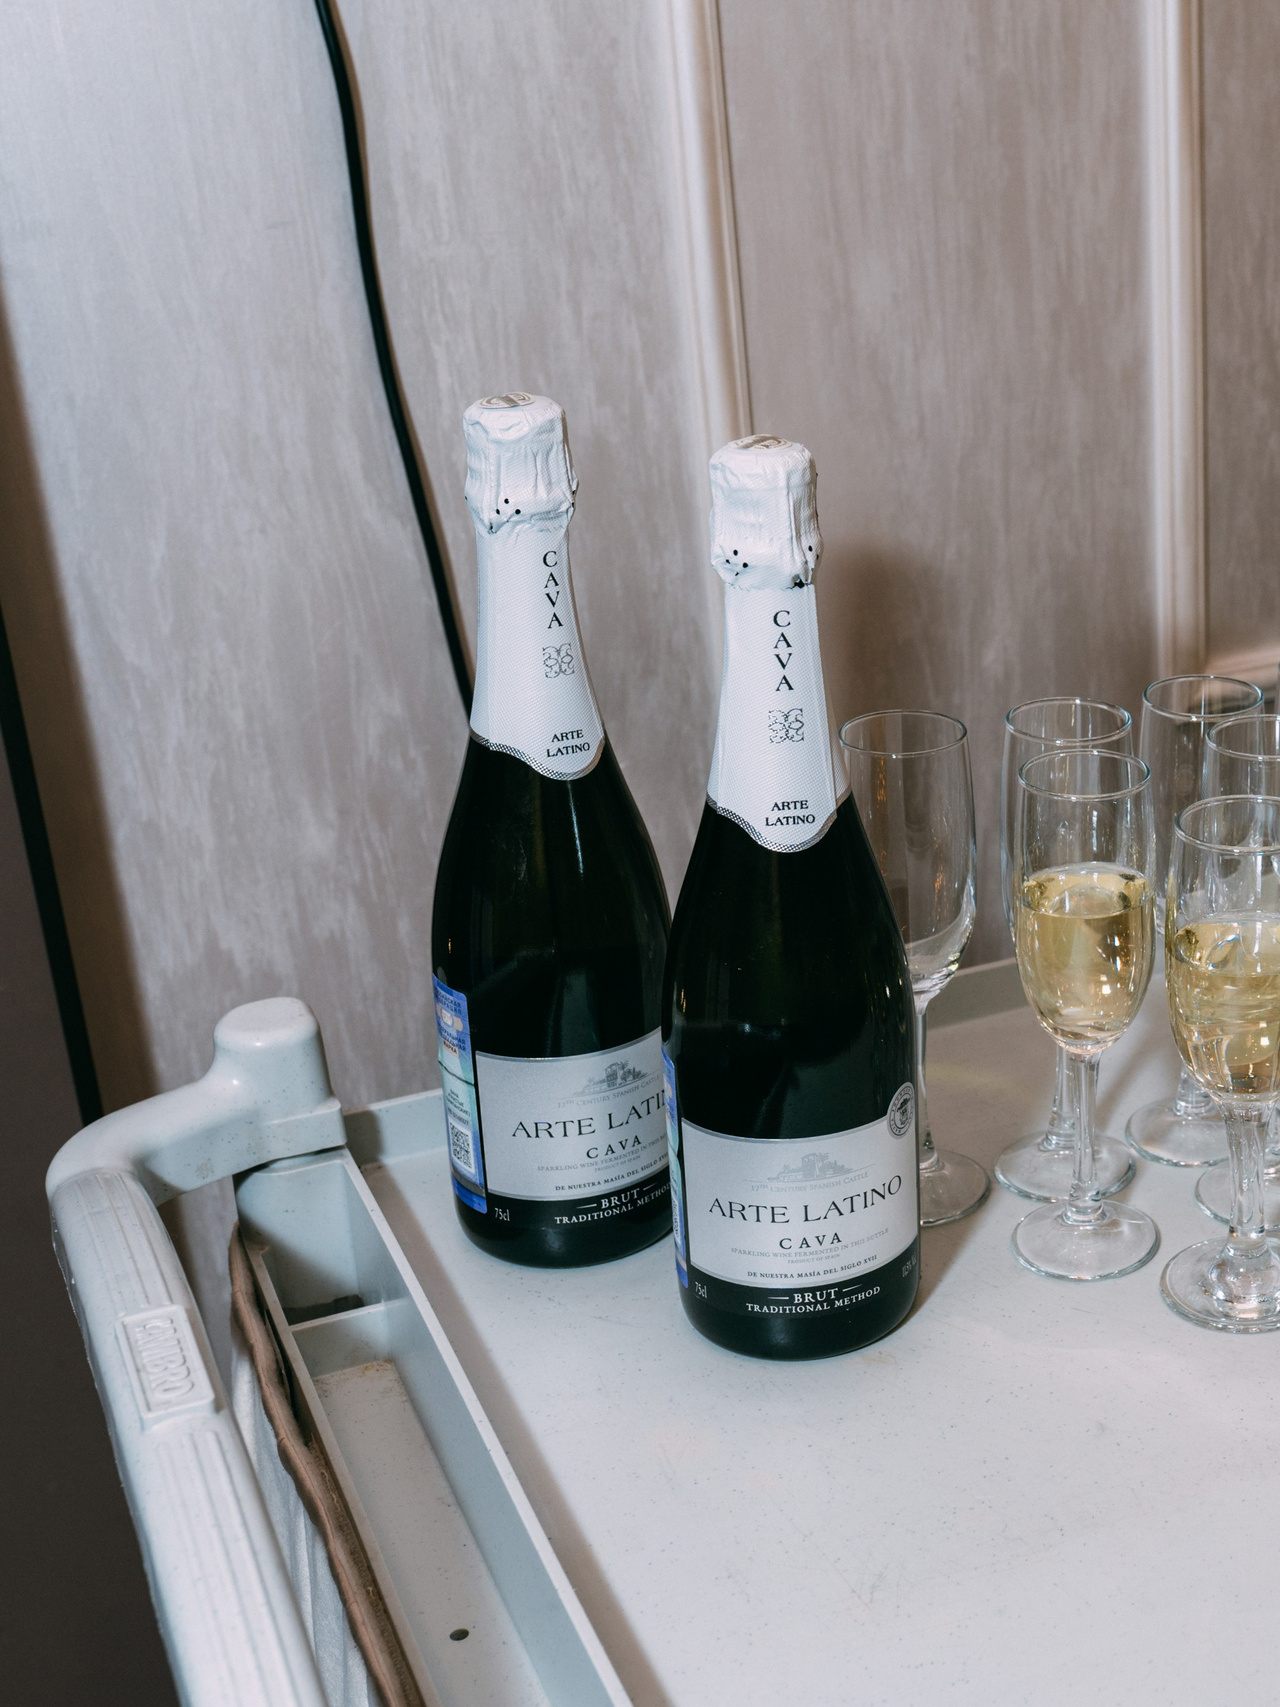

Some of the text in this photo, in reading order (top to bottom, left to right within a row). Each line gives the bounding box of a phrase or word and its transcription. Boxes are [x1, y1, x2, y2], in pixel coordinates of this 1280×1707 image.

[542, 551, 563, 628] CAVA
[773, 610, 794, 692] CAVA
[551, 729, 584, 742] ARTE
[546, 742, 590, 758] LATINO
[771, 800, 809, 812] ARTE
[765, 814, 816, 827] LATINO
[613, 1085, 639, 1098] SPANISH
[512, 1117, 596, 1139] ARTE
[608, 1089, 665, 1130] LATI
[586, 1135, 642, 1159] CAVA
[580, 1161, 598, 1169] WINE
[601, 1147, 640, 1164] FERMENTED
[568, 1181, 601, 1190] NUESTRA
[604, 1174, 625, 1184] MASÍA
[626, 1169, 639, 1178] DEL
[641, 1159, 658, 1171] SIGLO
[770, 1184, 807, 1193] CENTURY
[810, 1180, 841, 1191] SPANISH
[843, 1172, 869, 1185] CASTLE
[601, 1188, 640, 1209] BRUT
[709, 1175, 902, 1224] ARTE LATINO
[494, 1207, 510, 1222] 75cl
[554, 1204, 634, 1224] TRADITIONAL
[731, 1247, 770, 1258] SPARKLING
[794, 1246, 839, 1257] FERMENTED
[850, 1239, 865, 1248] THIS
[866, 1228, 889, 1241] BOTTLE
[779, 1232, 842, 1250] CAVA
[797, 1270, 821, 1278] MASÍA
[823, 1267, 838, 1275] DEL
[840, 1260, 862, 1271] SIGLO
[863, 1255, 877, 1265] XVII
[694, 1281, 708, 1299] 75cl
[746, 1286, 881, 1314] TRADITIONAL METHOD
[793, 1288, 838, 1304] BRUT
